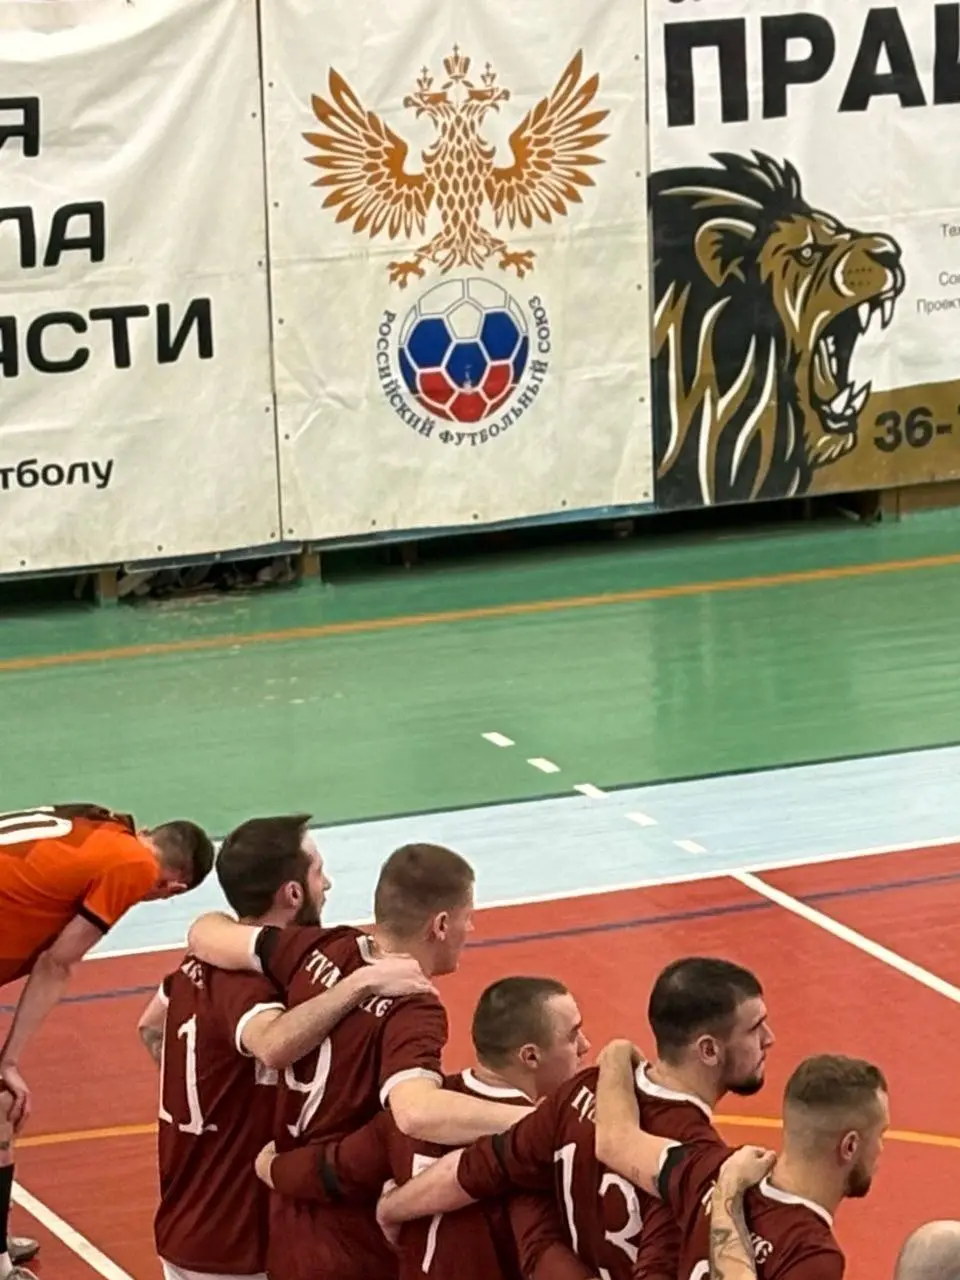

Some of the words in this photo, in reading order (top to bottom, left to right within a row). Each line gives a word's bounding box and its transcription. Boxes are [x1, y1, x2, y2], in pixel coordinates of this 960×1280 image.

[376, 309, 436, 438] РОССИЙСКИЙ
[438, 359, 549, 446] ФУТБОЛЬНЫЙ
[528, 295, 551, 354] СОЮЗ
